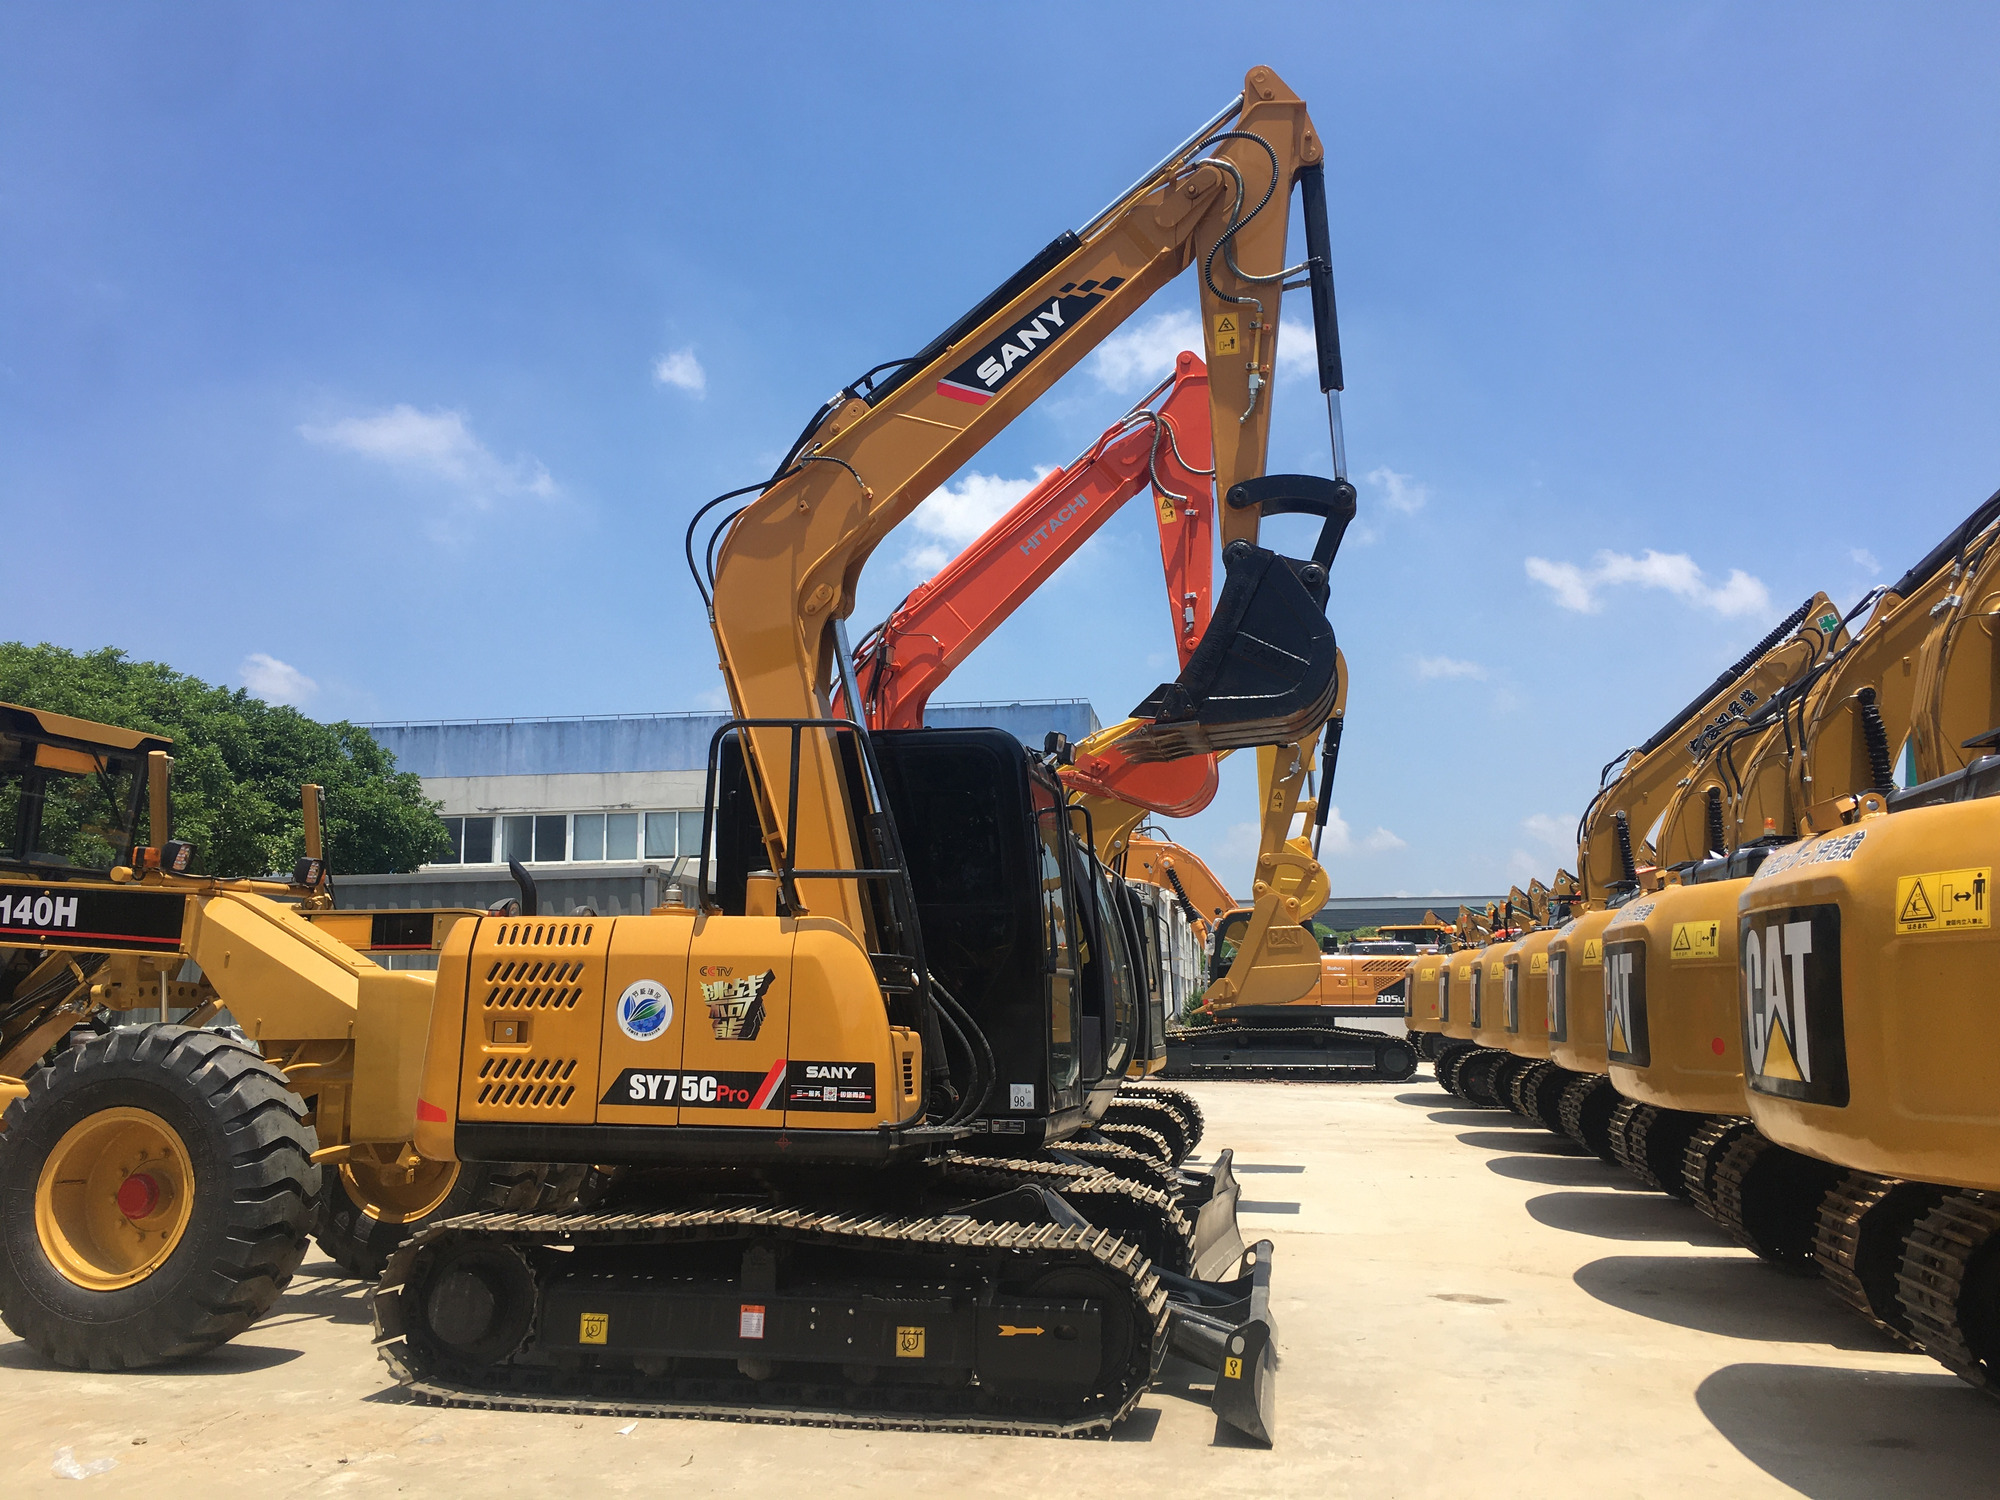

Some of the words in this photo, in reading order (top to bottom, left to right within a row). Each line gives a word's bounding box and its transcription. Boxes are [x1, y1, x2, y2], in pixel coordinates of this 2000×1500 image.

[976, 299, 1065, 388] SANY
[1019, 493, 1089, 556] HITACHI
[0, 894, 78, 927] 140H
[1268, 928, 1301, 946] CAT
[699, 965, 734, 977] CCTV
[699, 971, 767, 1000] 挑战
[704, 996, 757, 1018] 不可
[1746, 920, 1812, 1082] CAT
[712, 1017, 746, 1038] 能
[805, 1065, 857, 1079] SANY
[1013, 1095, 1025, 1107] 98
